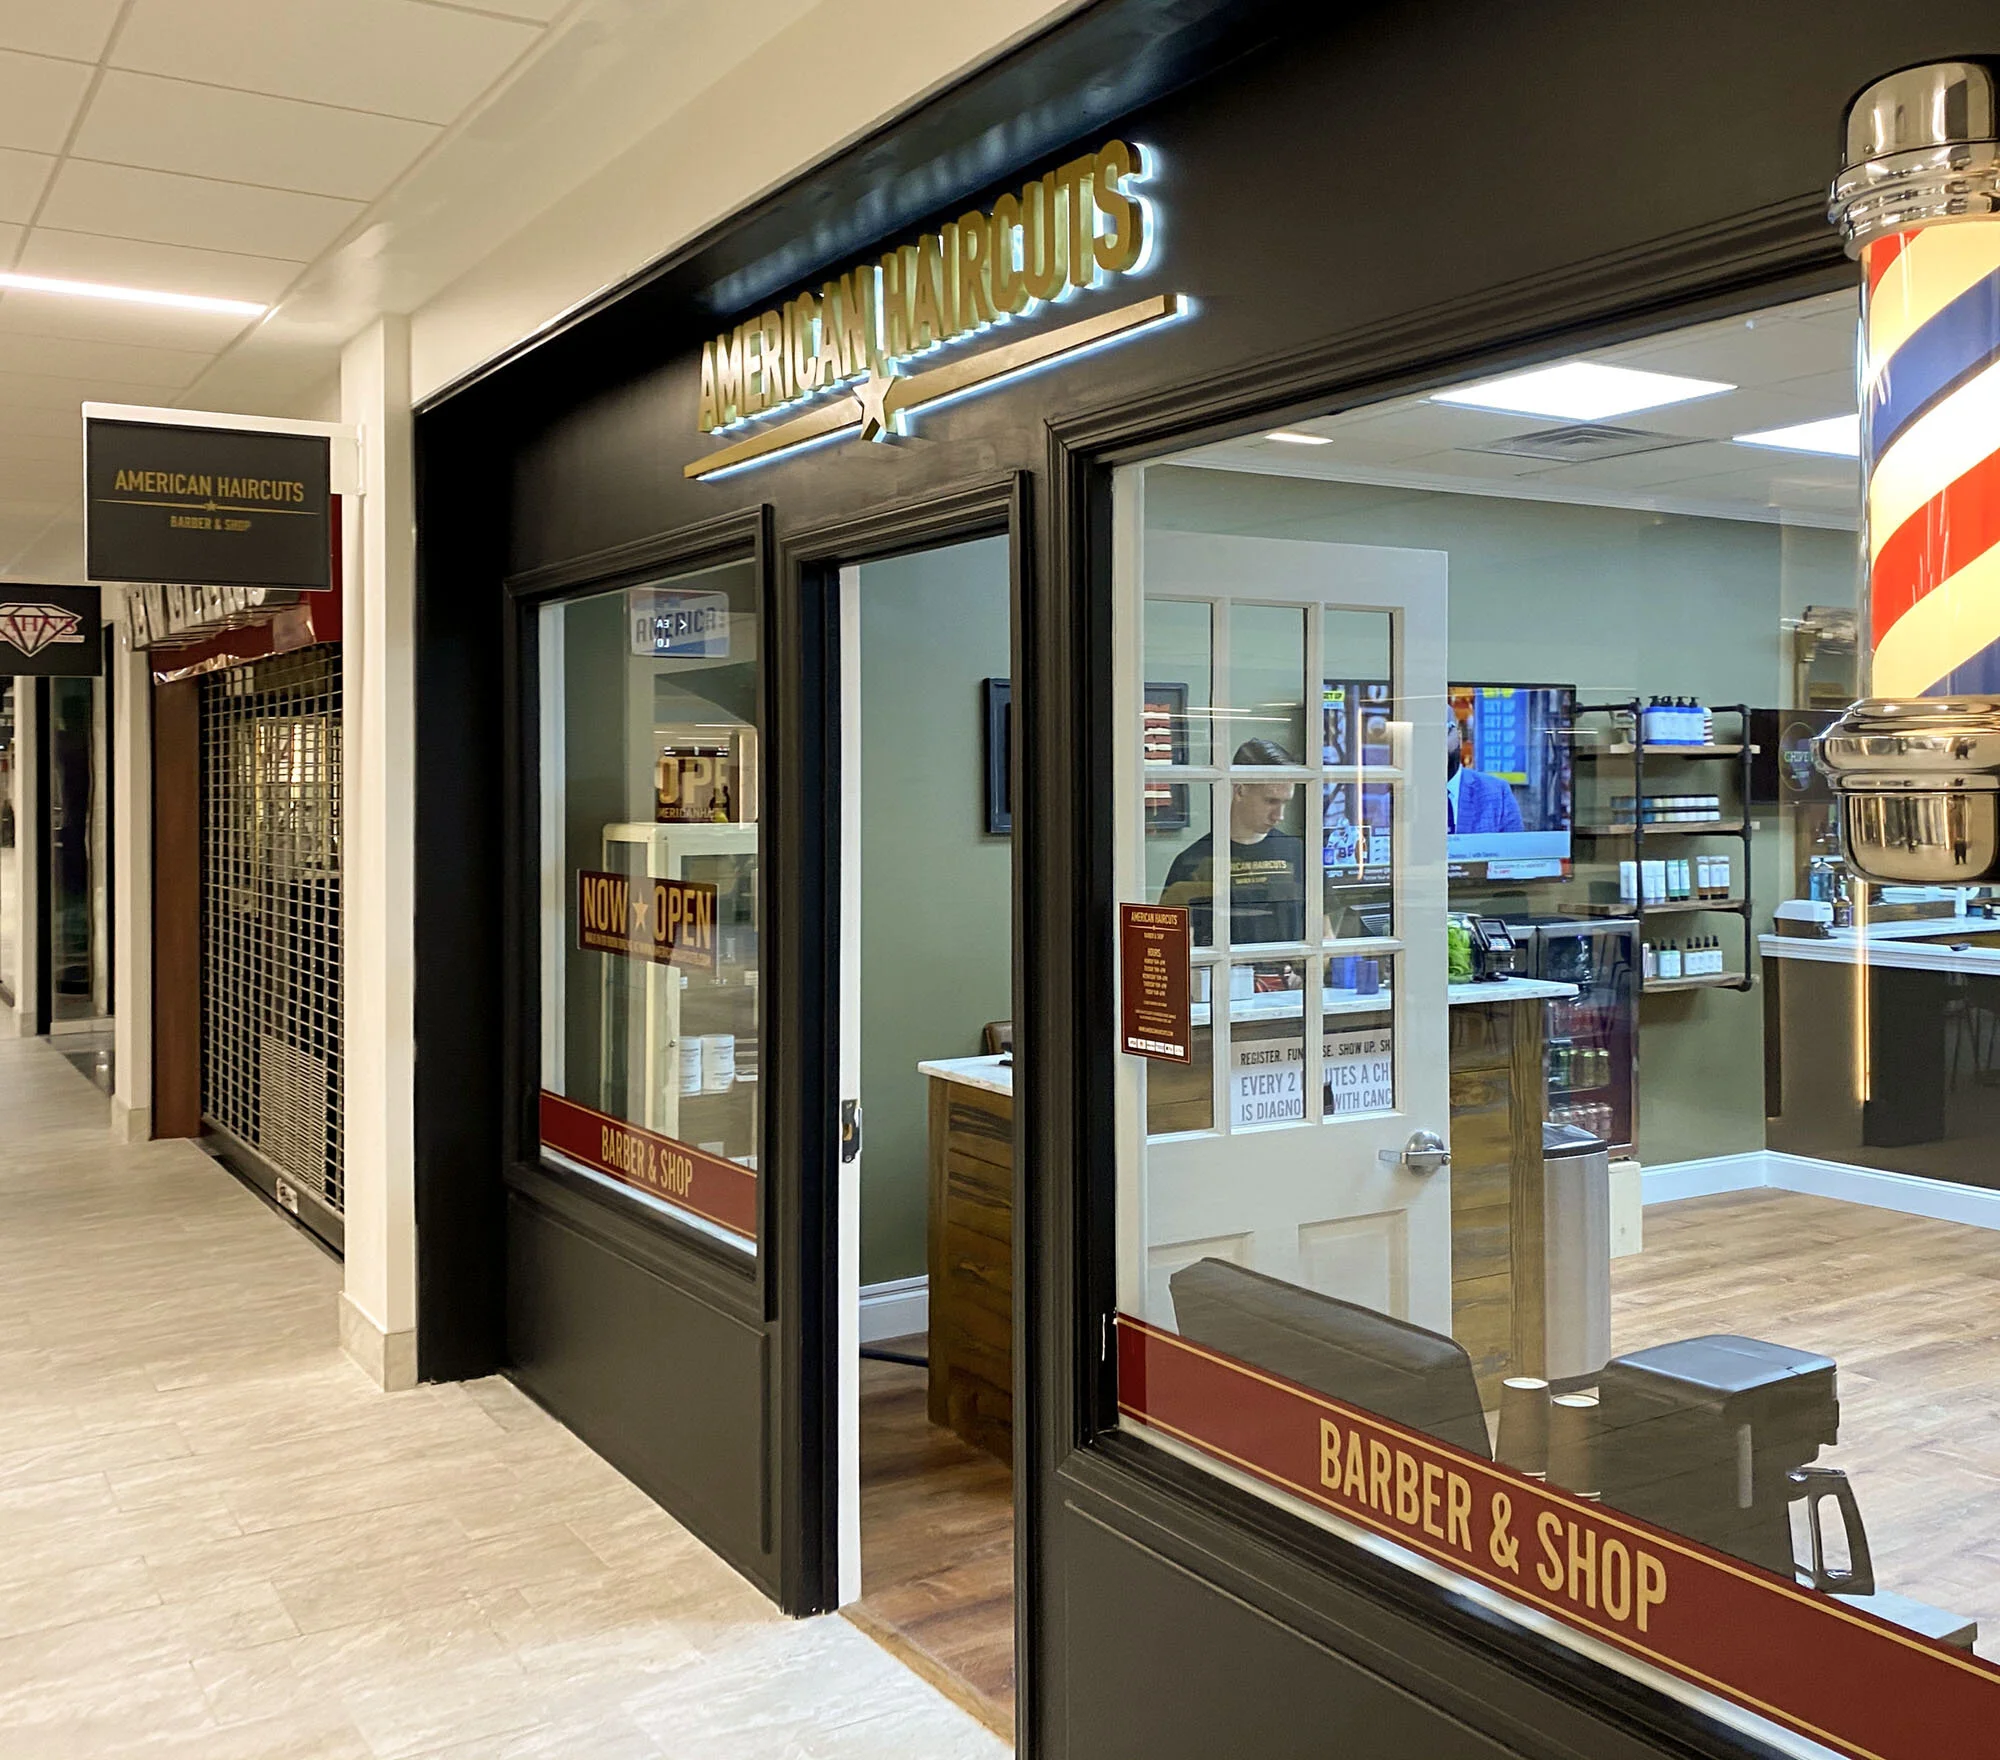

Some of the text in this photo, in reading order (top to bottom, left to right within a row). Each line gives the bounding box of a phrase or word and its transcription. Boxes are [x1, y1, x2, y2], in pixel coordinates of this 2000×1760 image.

[699, 138, 1146, 432] AMERICAN HAIRCUTS
[114, 469, 305, 503] AMERICAN HAIRCUTS
[170, 515, 212, 530] BARBER
[224, 519, 252, 532] SHOP
[584, 877, 629, 934] NOW
[653, 885, 711, 950] OPEN
[1240, 1048, 1282, 1066] REGISTER.
[1339, 1041, 1361, 1057] SHOW
[1241, 1072, 1283, 1097] EVERY
[1287, 1071, 1295, 1092] 2
[1360, 1064, 1369, 1085] A
[1241, 1103, 1253, 1122] IS
[1256, 1098, 1301, 1121] DIAGNO
[1363, 1088, 1391, 1107] CANC
[601, 1124, 693, 1198] BARBER & SHOP
[1319, 1417, 1667, 1633] BARBER & SHOP
